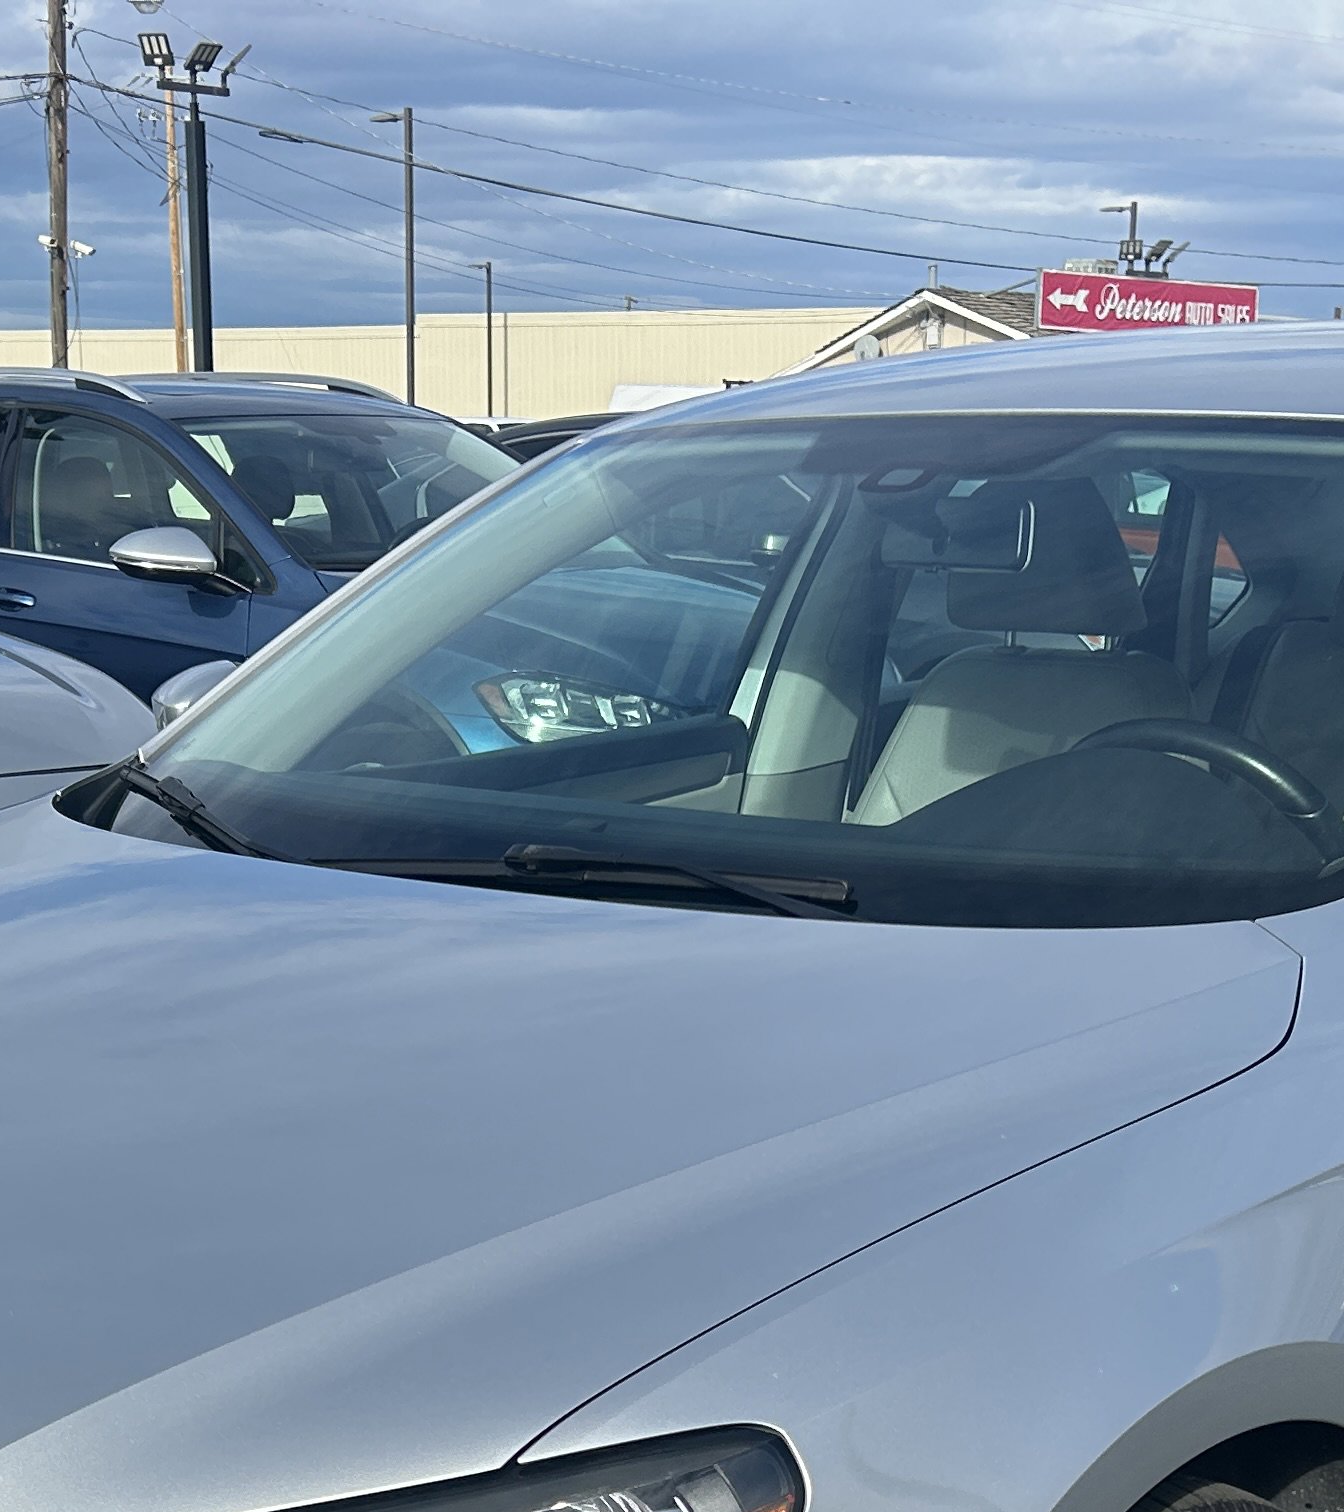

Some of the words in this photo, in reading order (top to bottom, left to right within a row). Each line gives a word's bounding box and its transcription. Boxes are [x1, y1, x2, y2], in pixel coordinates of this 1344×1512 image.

[1095, 282, 1183, 323] Peterson
[1185, 301, 1214, 325] AUTO
[1217, 303, 1250, 324] SALES
